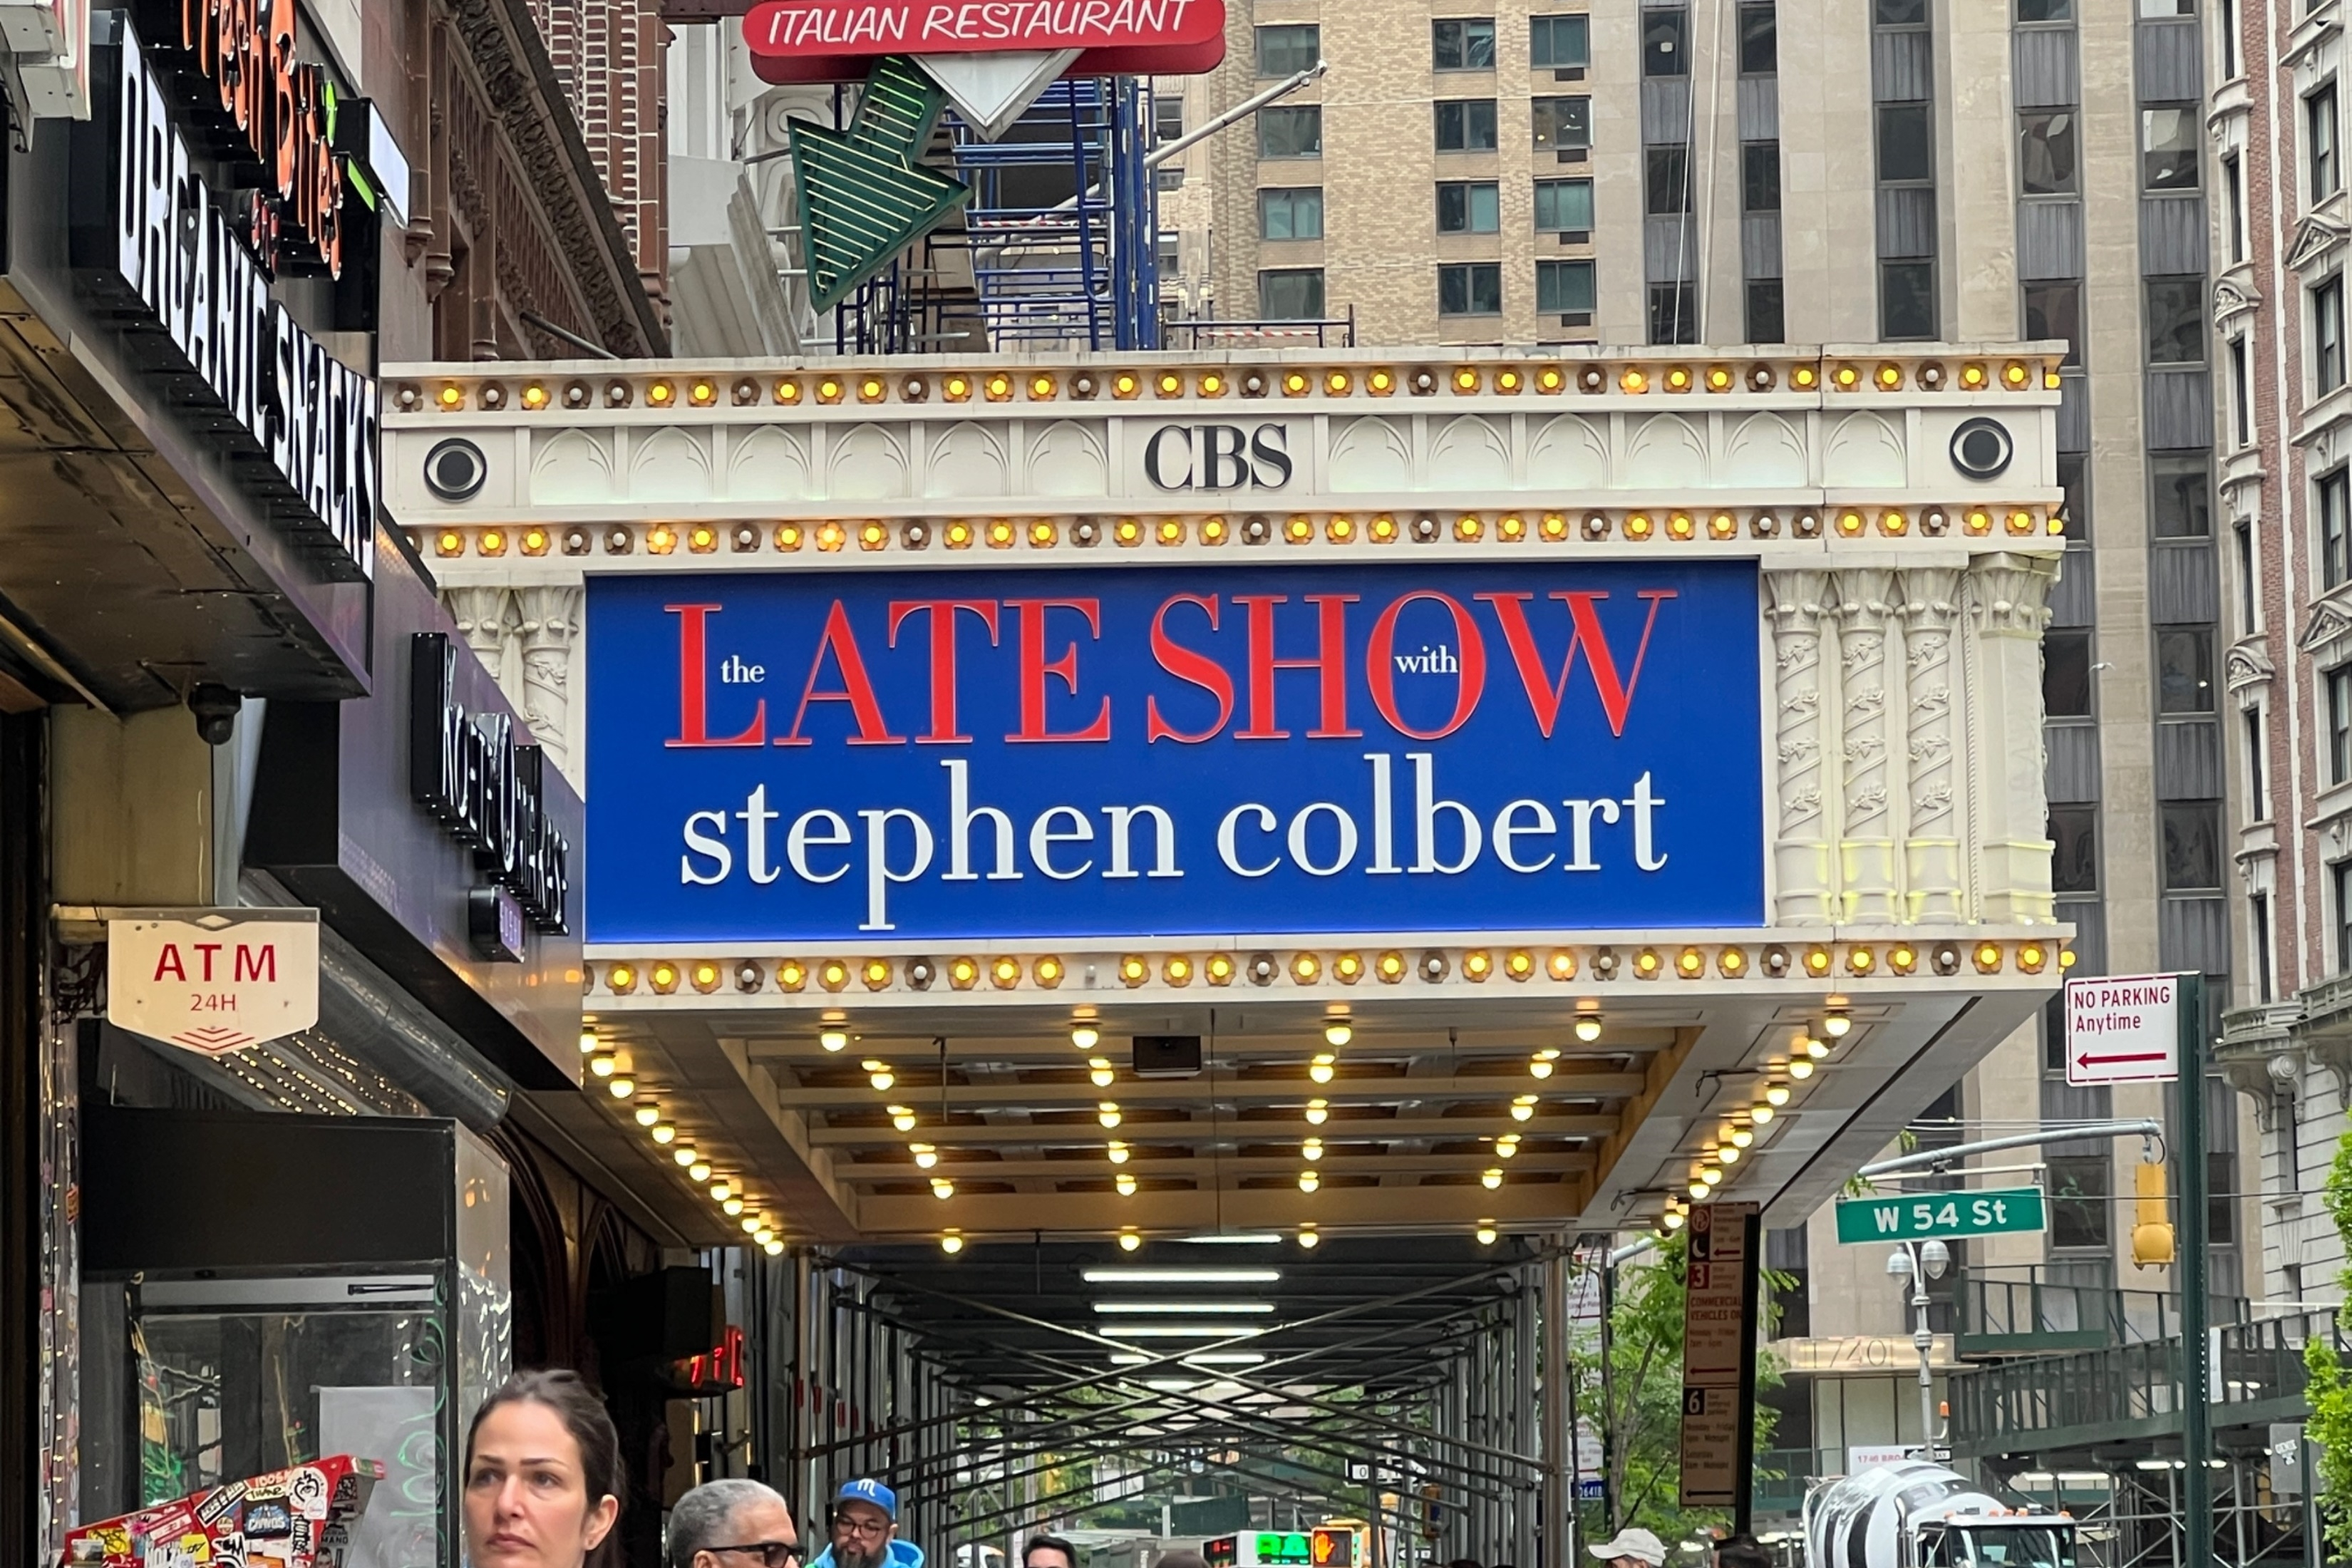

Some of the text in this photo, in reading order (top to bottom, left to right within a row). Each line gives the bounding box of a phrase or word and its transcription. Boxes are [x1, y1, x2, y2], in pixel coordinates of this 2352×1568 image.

[768, 0, 1197, 45] ITALIAN RESTAURANT
[119, 9, 376, 582] ORGANIC SNACKS
[1145, 423, 1292, 491] CBS
[664, 589, 1678, 748] LATE SHOW
[721, 655, 765, 684] the
[1394, 645, 1458, 674] with
[681, 752, 1668, 932] stephen colbert
[153, 943, 277, 983] ATM
[190, 994, 237, 1011] 24H
[2075, 986, 2170, 1009] NO PARKING
[2075, 1012, 2142, 1036] Anytime
[1873, 1199, 2008, 1233] W 54 St
[1693, 1264, 1706, 1288] 3
[1812, 1338, 1888, 1368] 1740
[1688, 1389, 1701, 1414] 6
